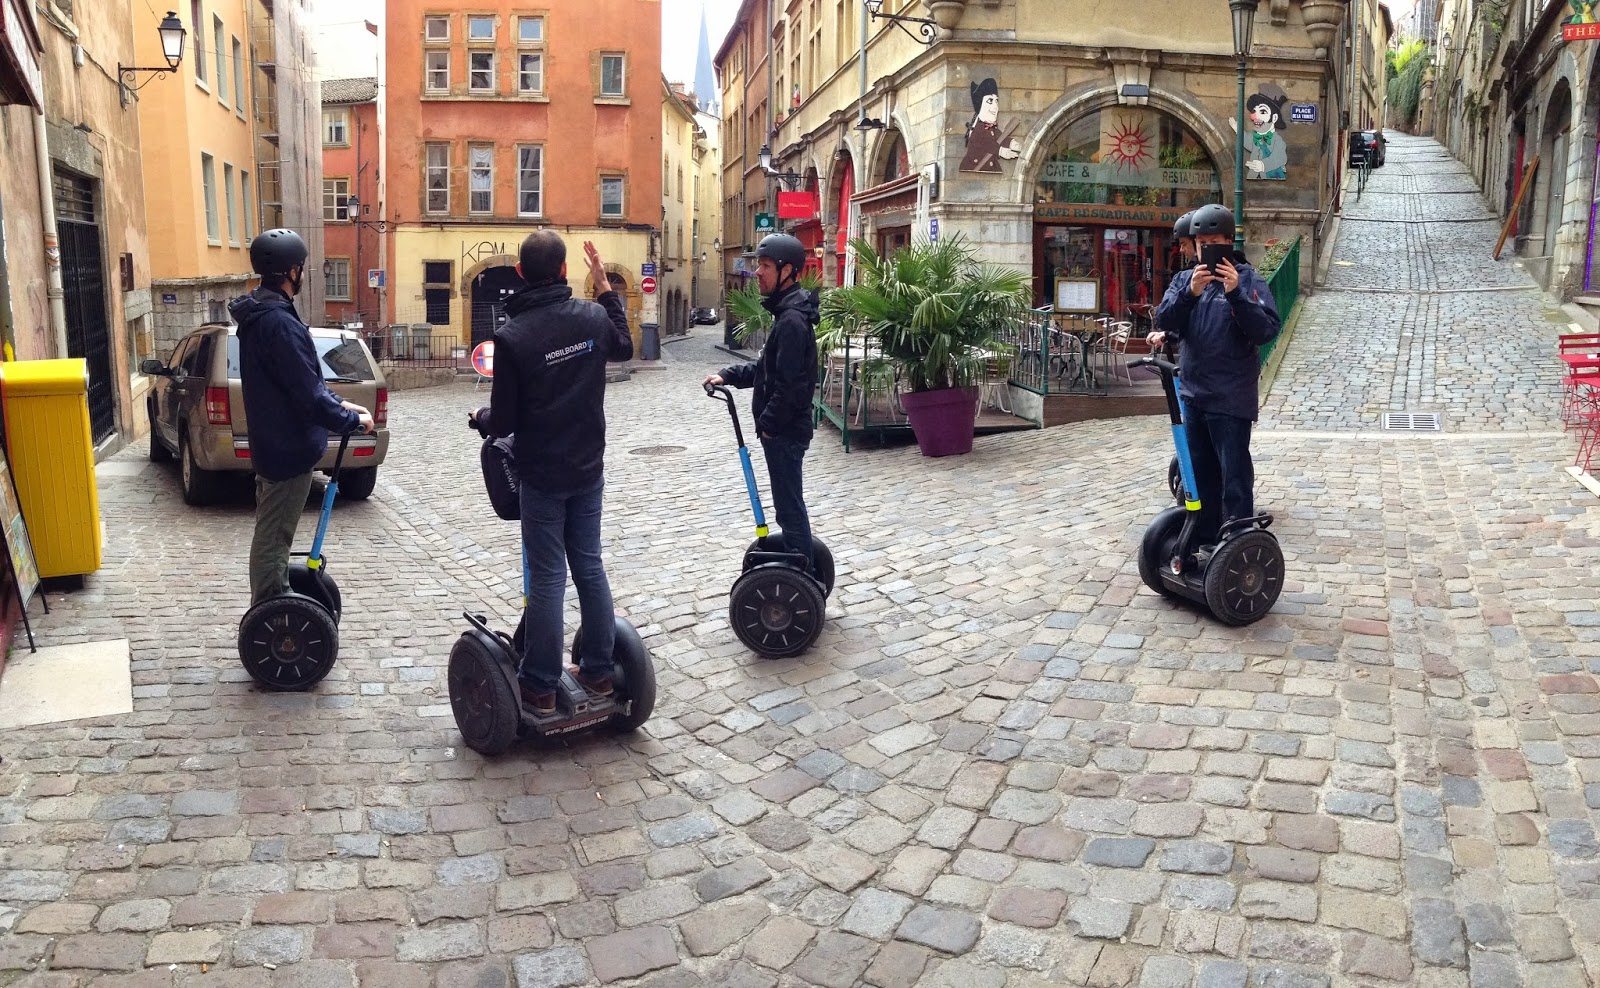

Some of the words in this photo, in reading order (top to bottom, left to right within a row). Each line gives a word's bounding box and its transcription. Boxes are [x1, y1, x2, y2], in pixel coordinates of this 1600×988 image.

[1565, 25, 1600, 37] THÉ
[1046, 164, 1075, 178] CAFE
[1082, 165, 1090, 178] &
[1074, 208, 1155, 221] RESTAURANT
[545, 341, 588, 361] MOBILBOARD
